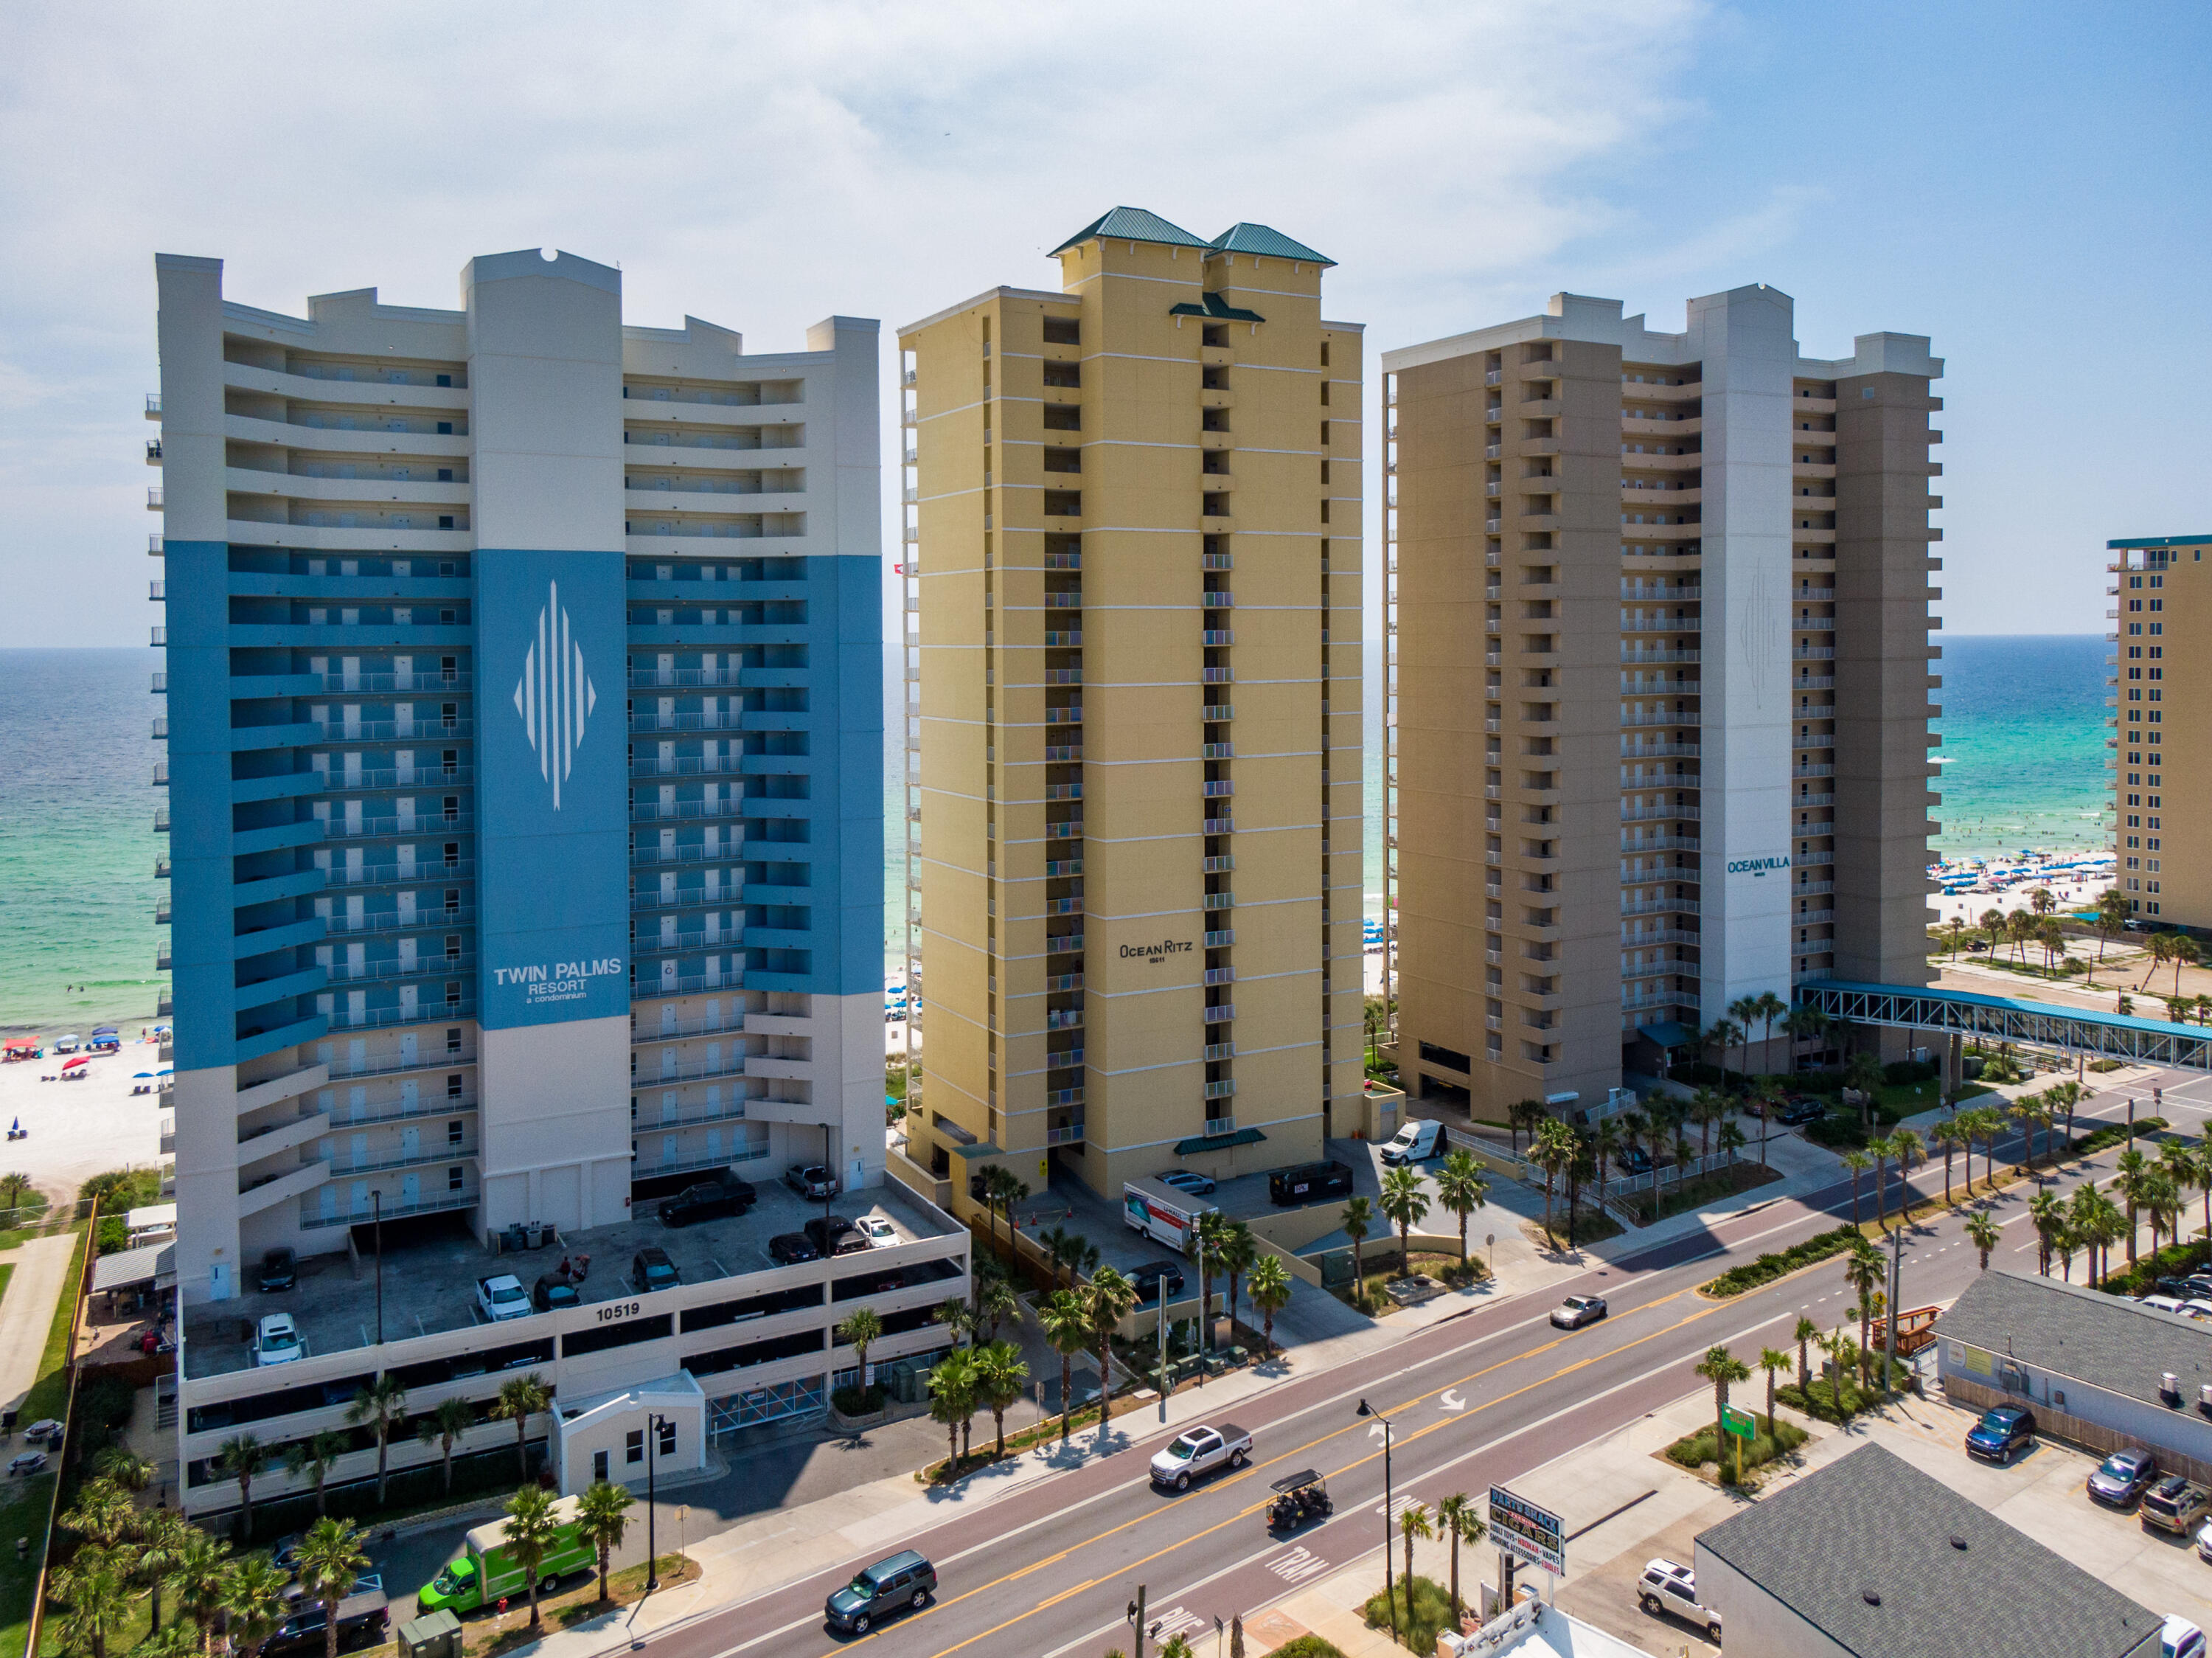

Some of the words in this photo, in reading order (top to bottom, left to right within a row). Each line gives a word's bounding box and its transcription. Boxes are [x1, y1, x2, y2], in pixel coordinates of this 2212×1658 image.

[1728, 859, 1762, 873] OCEAN
[1762, 856, 1790, 870] VILLA
[494, 965, 547, 985] TWIN
[556, 958, 622, 979] PALMS
[529, 979, 587, 995] RESORT
[535, 992, 587, 1003] condominium
[596, 1303, 640, 1322] 10519
[1492, 1489, 1523, 1512] PARTY
[1525, 1505, 1558, 1534] SHACK
[1490, 1523, 1503, 1535] ADULT
[1503, 1530, 1514, 1541] TOYS
[1517, 1536, 1539, 1554] HOOKAH
[1542, 1549, 1559, 1564] VAPES
[1491, 1507, 1558, 1550] CIGARS
[1265, 1546, 1329, 1583] TRAM
[1490, 1533, 1510, 1550] SMOKING
[1510, 1544, 1540, 1565] ACCESSORIES
[1541, 1559, 1559, 1575] EDIBLES
